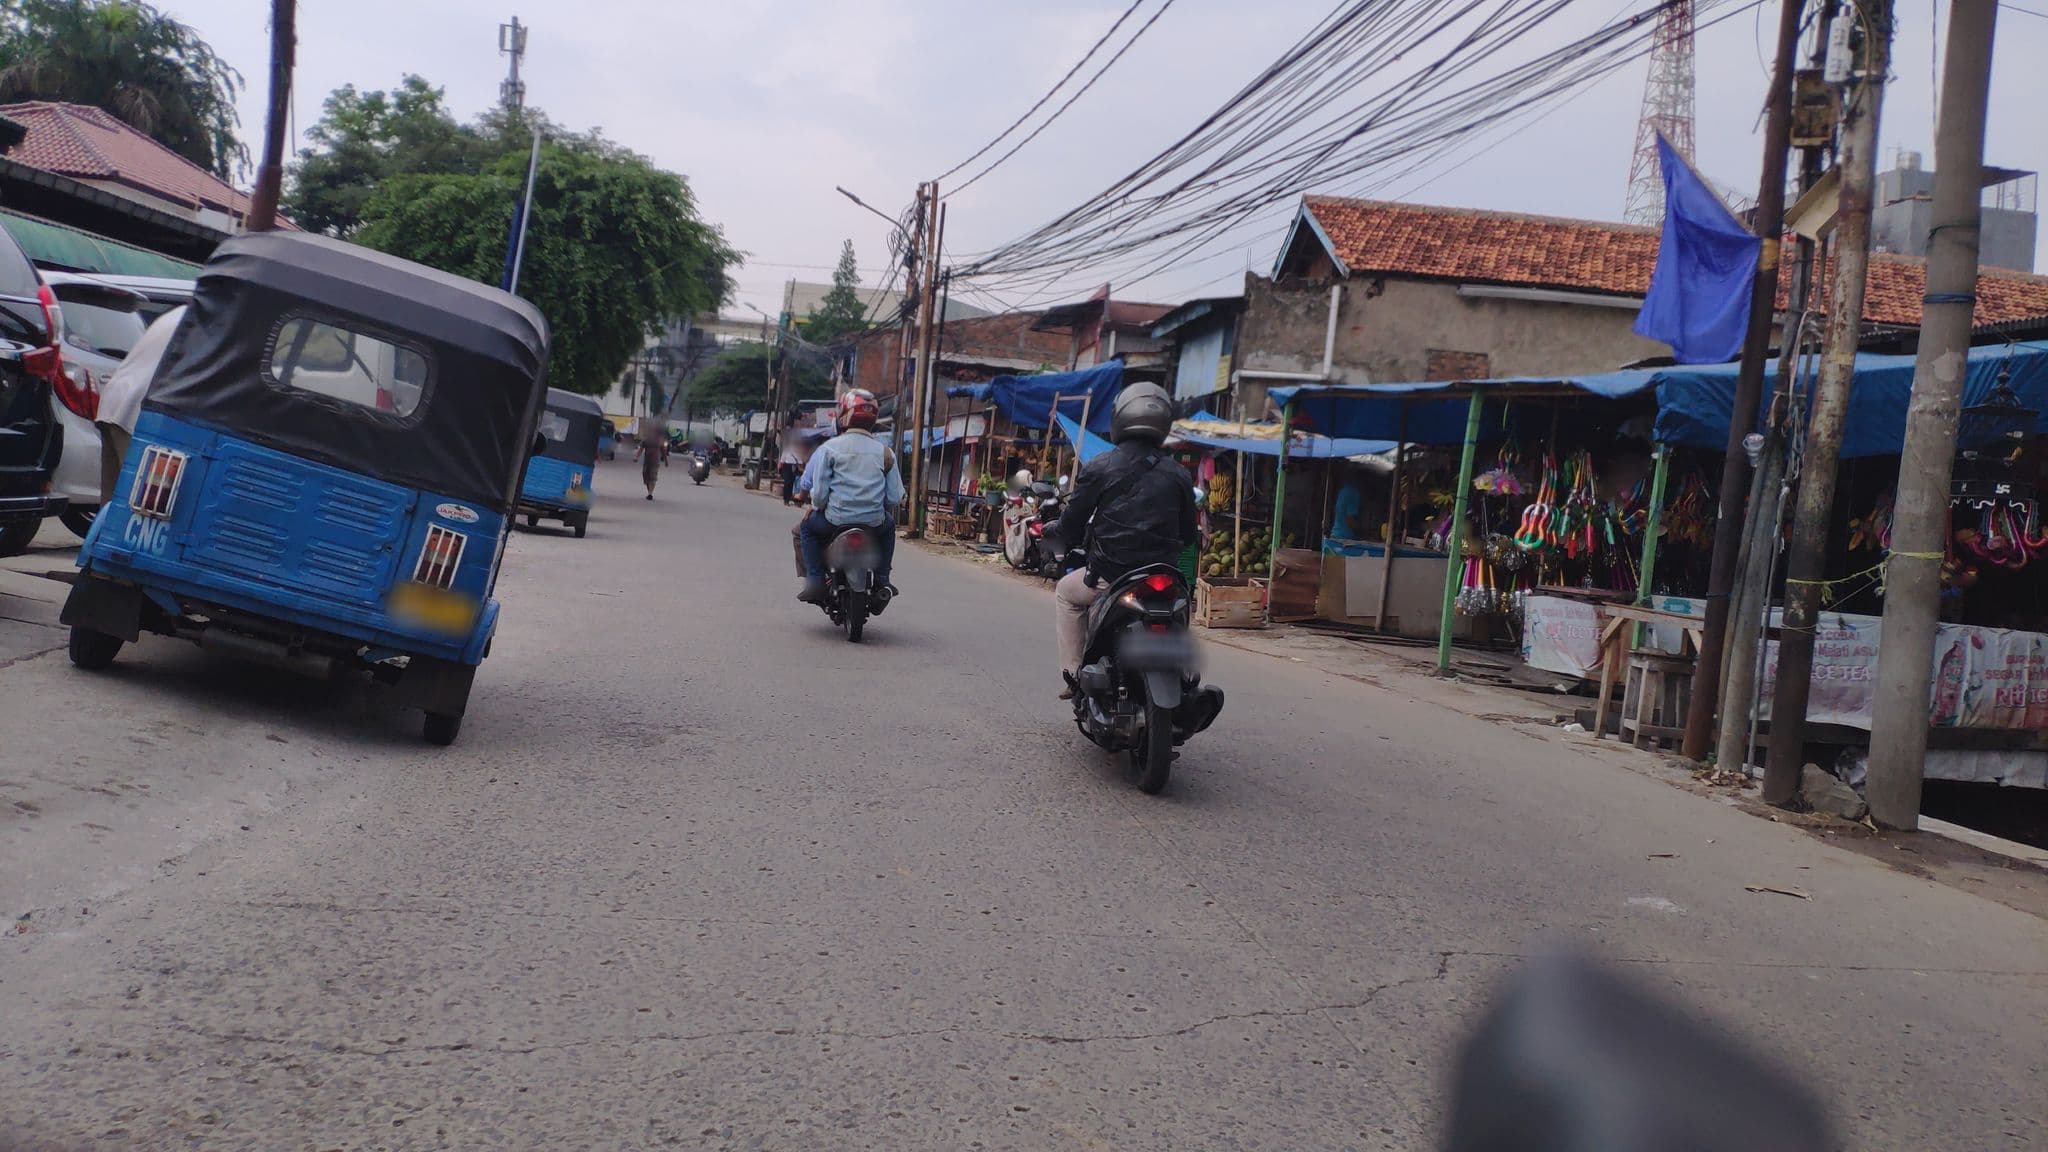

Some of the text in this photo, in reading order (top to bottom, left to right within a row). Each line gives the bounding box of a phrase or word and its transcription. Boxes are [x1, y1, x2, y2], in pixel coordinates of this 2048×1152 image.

[125, 513, 169, 555] CNG
[1840, 665, 1873, 681] TEA
[1984, 669, 2023, 680] SEGAR
